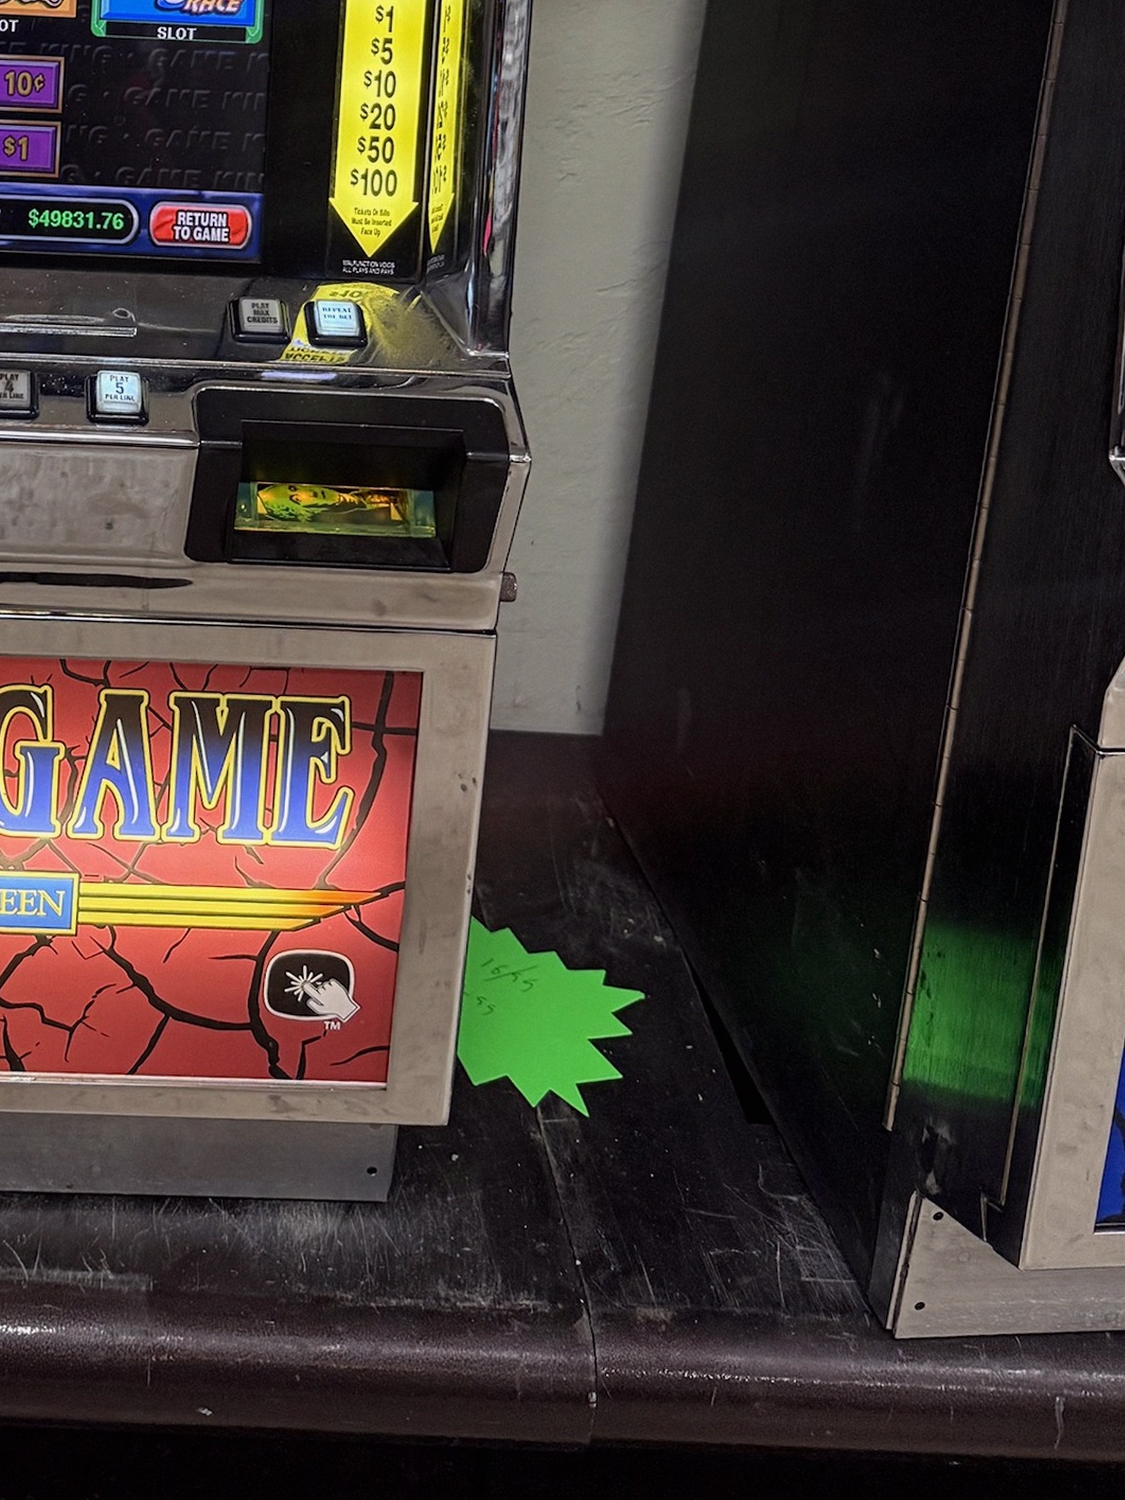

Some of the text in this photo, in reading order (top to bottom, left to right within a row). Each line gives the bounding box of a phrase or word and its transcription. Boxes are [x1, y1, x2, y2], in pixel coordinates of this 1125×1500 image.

[375, 5, 394, 32] $1
[157, 26, 197, 41] SLOT
[371, 37, 393, 65] $5
[4, 71, 46, 97] 10¢
[364, 70, 397, 98] $10
[360, 103, 396, 130] $20
[3, 135, 30, 161] $1
[357, 136, 395, 164] $50
[350, 168, 398, 197] $100
[28, 208, 124, 230] $49831.76
[177, 211, 228, 227] RETURN
[174, 225, 229, 242] TO GAME
[247, 315, 278, 323] CREDITS
[0, 373, 19, 381] PLAY
[109, 375, 129, 383] PLAY
[115, 382, 124, 395] 5
